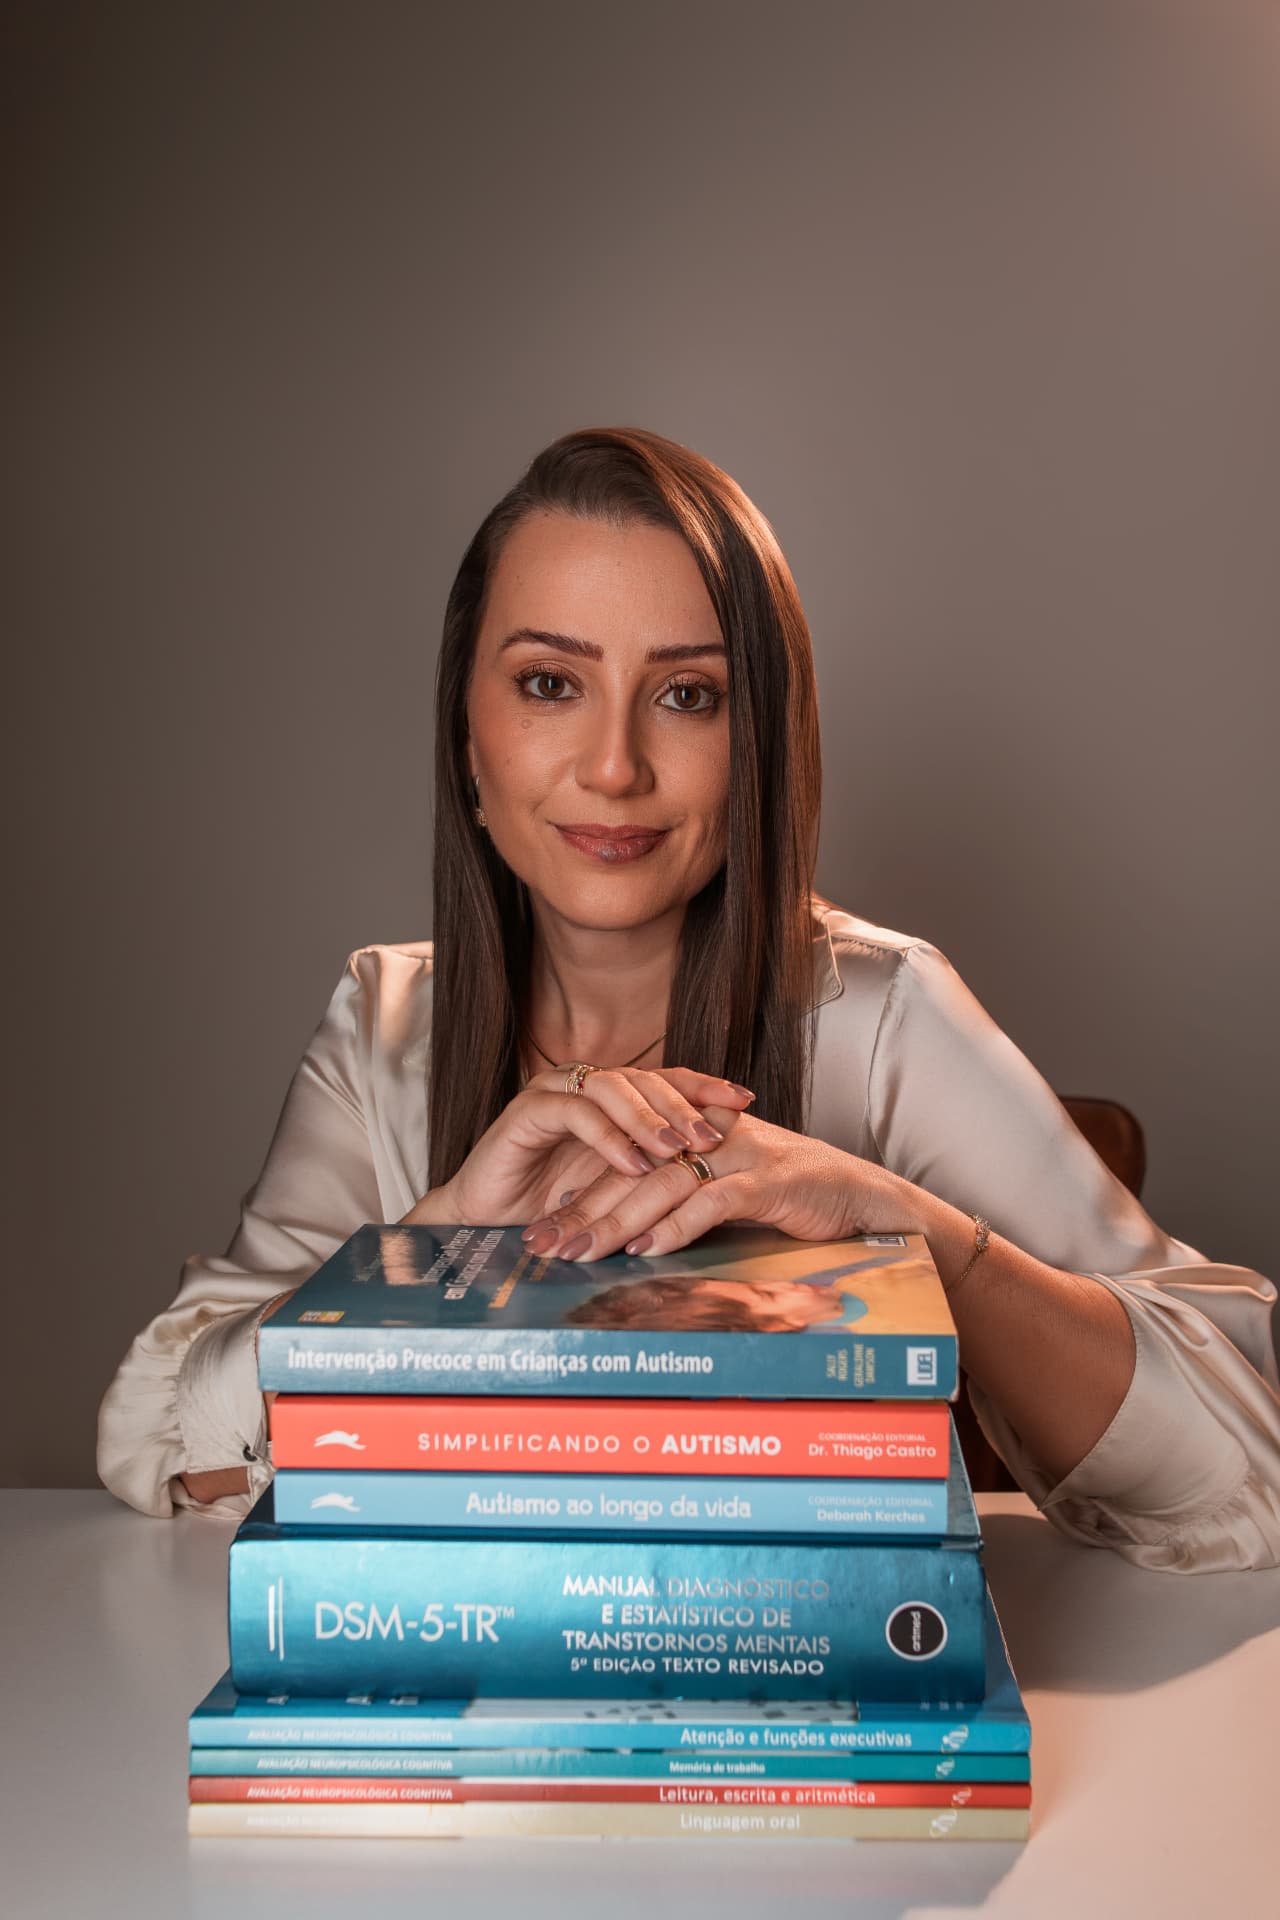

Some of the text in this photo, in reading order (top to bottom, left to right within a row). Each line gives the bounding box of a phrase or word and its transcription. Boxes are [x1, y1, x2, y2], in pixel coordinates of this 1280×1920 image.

[288, 1347, 713, 1376] Intervenção Precoce em Crianças com Autismo
[418, 1433, 782, 1456] SIMPLIFICANDO O AUTISMO
[818, 1432, 926, 1442] COORDENAÇÃO EDITORIAL
[808, 1443, 937, 1460] Dr. Thiago Castro
[466, 1492, 752, 1522] Autismo ao longo da vida
[817, 1508, 926, 1523] Deborah Kerches
[562, 1575, 830, 1601] MANUAL DIAGNÓSTICO
[601, 1602, 791, 1628] E ESTATÍSTICO DE
[562, 1630, 830, 1655] TRANSTORNOS MENTAIS
[593, 1655, 656, 1675] EDIÇÃO
[662, 1657, 721, 1674] TEXTO
[728, 1658, 824, 1676] REVISADO
[681, 1728, 912, 1749] Atenção e funções executivas
[670, 1761, 765, 1774] Memória de trabalho
[659, 1787, 875, 1805] Leitura, escrita e aritmética
[681, 1813, 800, 1833] Linguagem oral
